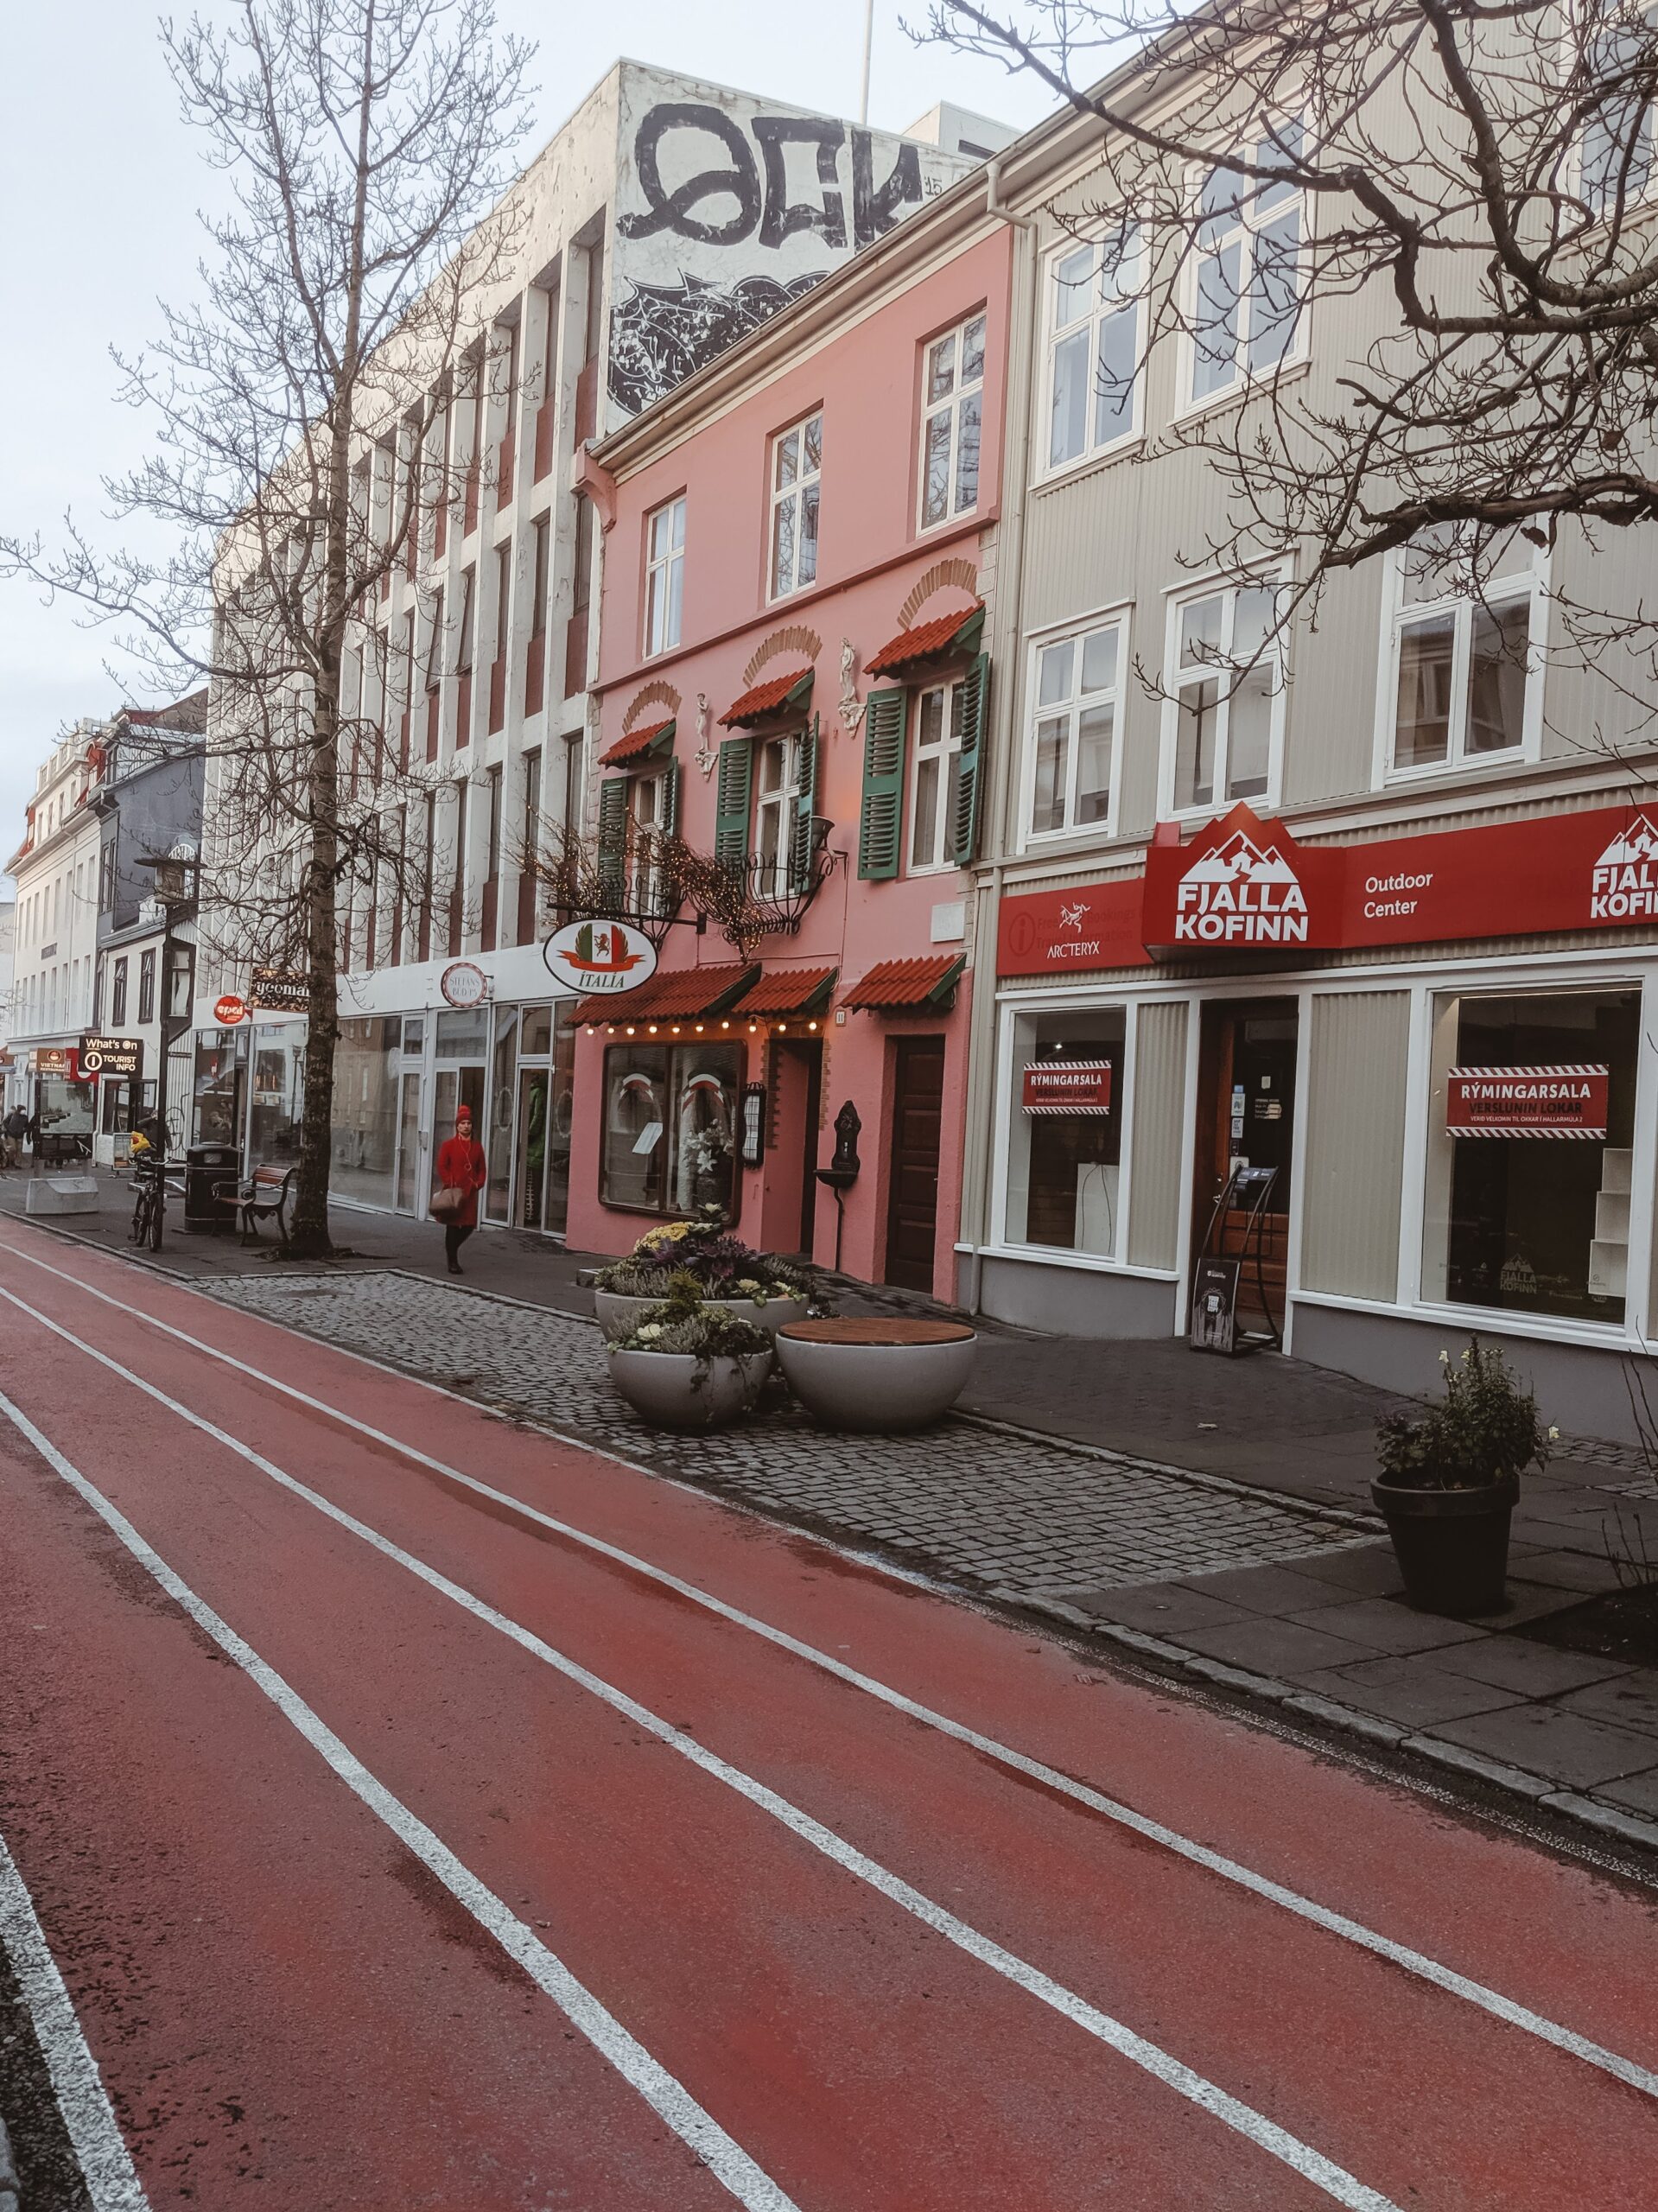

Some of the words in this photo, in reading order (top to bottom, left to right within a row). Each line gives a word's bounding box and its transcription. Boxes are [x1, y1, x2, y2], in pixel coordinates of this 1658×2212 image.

[1365, 873, 1433, 893] Outdoor
[1592, 864, 1658, 895] FJAL
[1178, 884, 1308, 915] FJALLA
[1363, 899, 1418, 918] Center
[1175, 914, 1308, 942] KOFINN
[579, 970, 626, 988] ÍTALÍA
[86, 1039, 120, 1049] What's
[122, 1040, 137, 1050] On
[103, 1054, 137, 1064] TOURIST
[1031, 1073, 1102, 1086] RÝMINGARSALA
[1461, 1082, 1591, 1099] RÝMINGARSALA
[1470, 1103, 1538, 1114] VERSLUNIN
[1540, 1103, 1582, 1113] LOKAR
